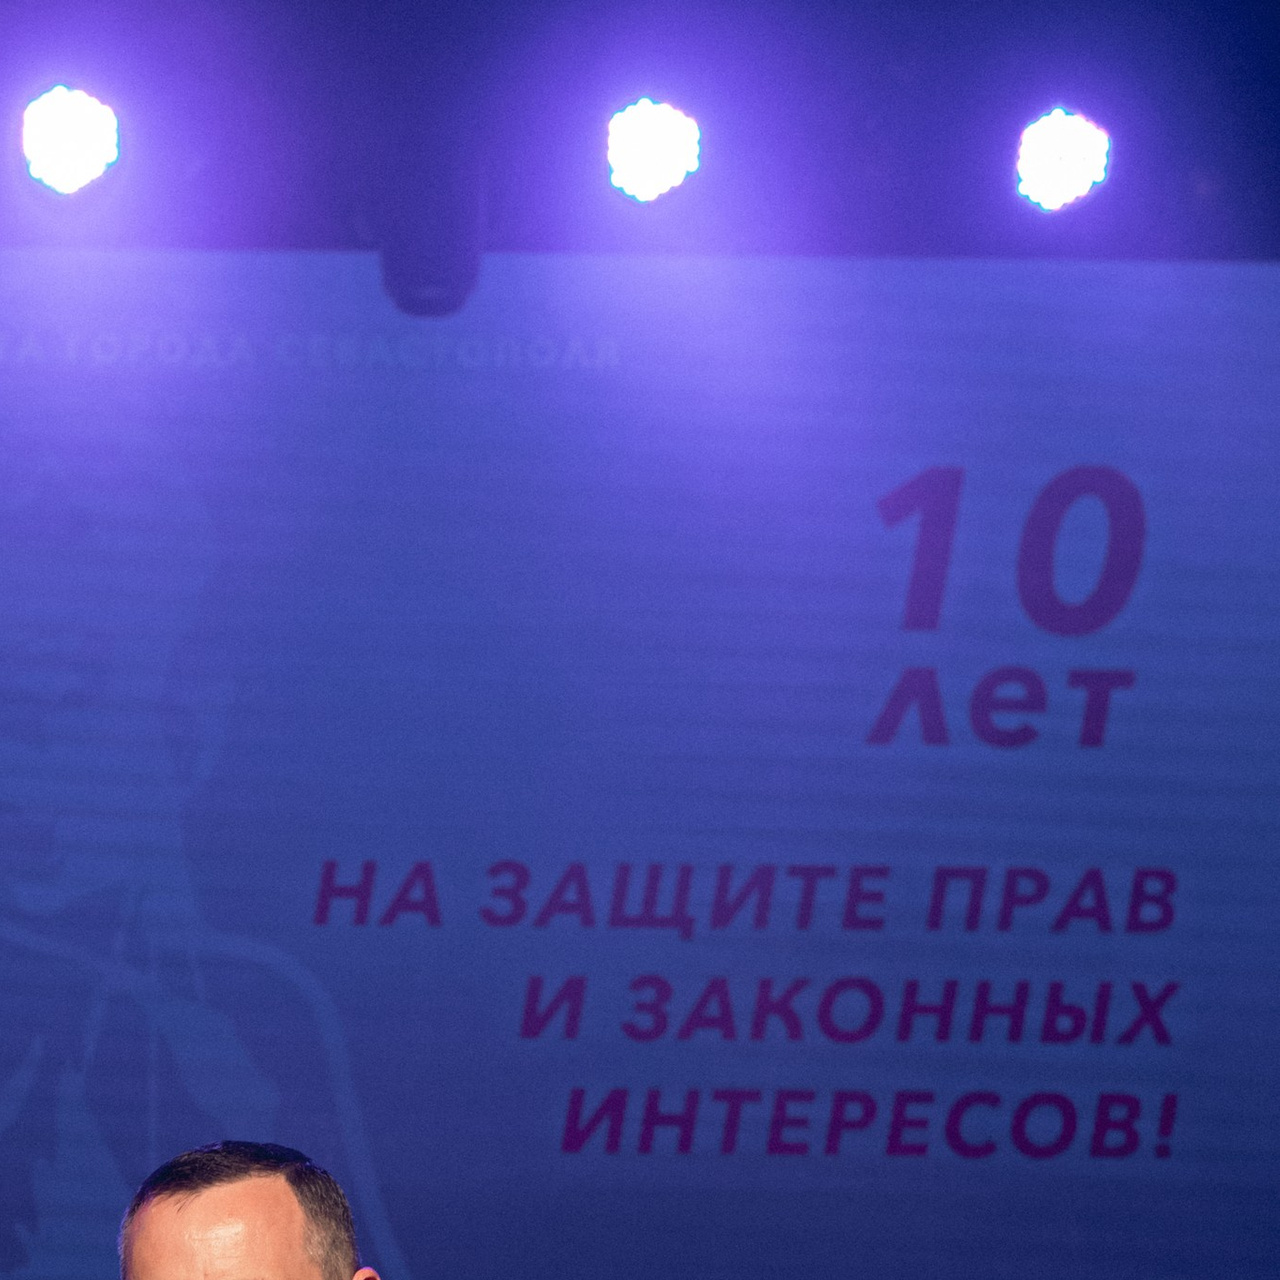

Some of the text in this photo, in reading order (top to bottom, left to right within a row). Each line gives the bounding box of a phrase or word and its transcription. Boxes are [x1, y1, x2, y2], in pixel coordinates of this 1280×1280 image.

[874, 464, 1148, 638] 10
[865, 665, 1135, 748] лет
[313, 860, 1179, 940] НА ЗАЩИТЕ ПРАВ
[519, 975, 1180, 1046] И ЗАКОННЫХ
[560, 1087, 1180, 1159] ИНТЕРЕСОВ!
